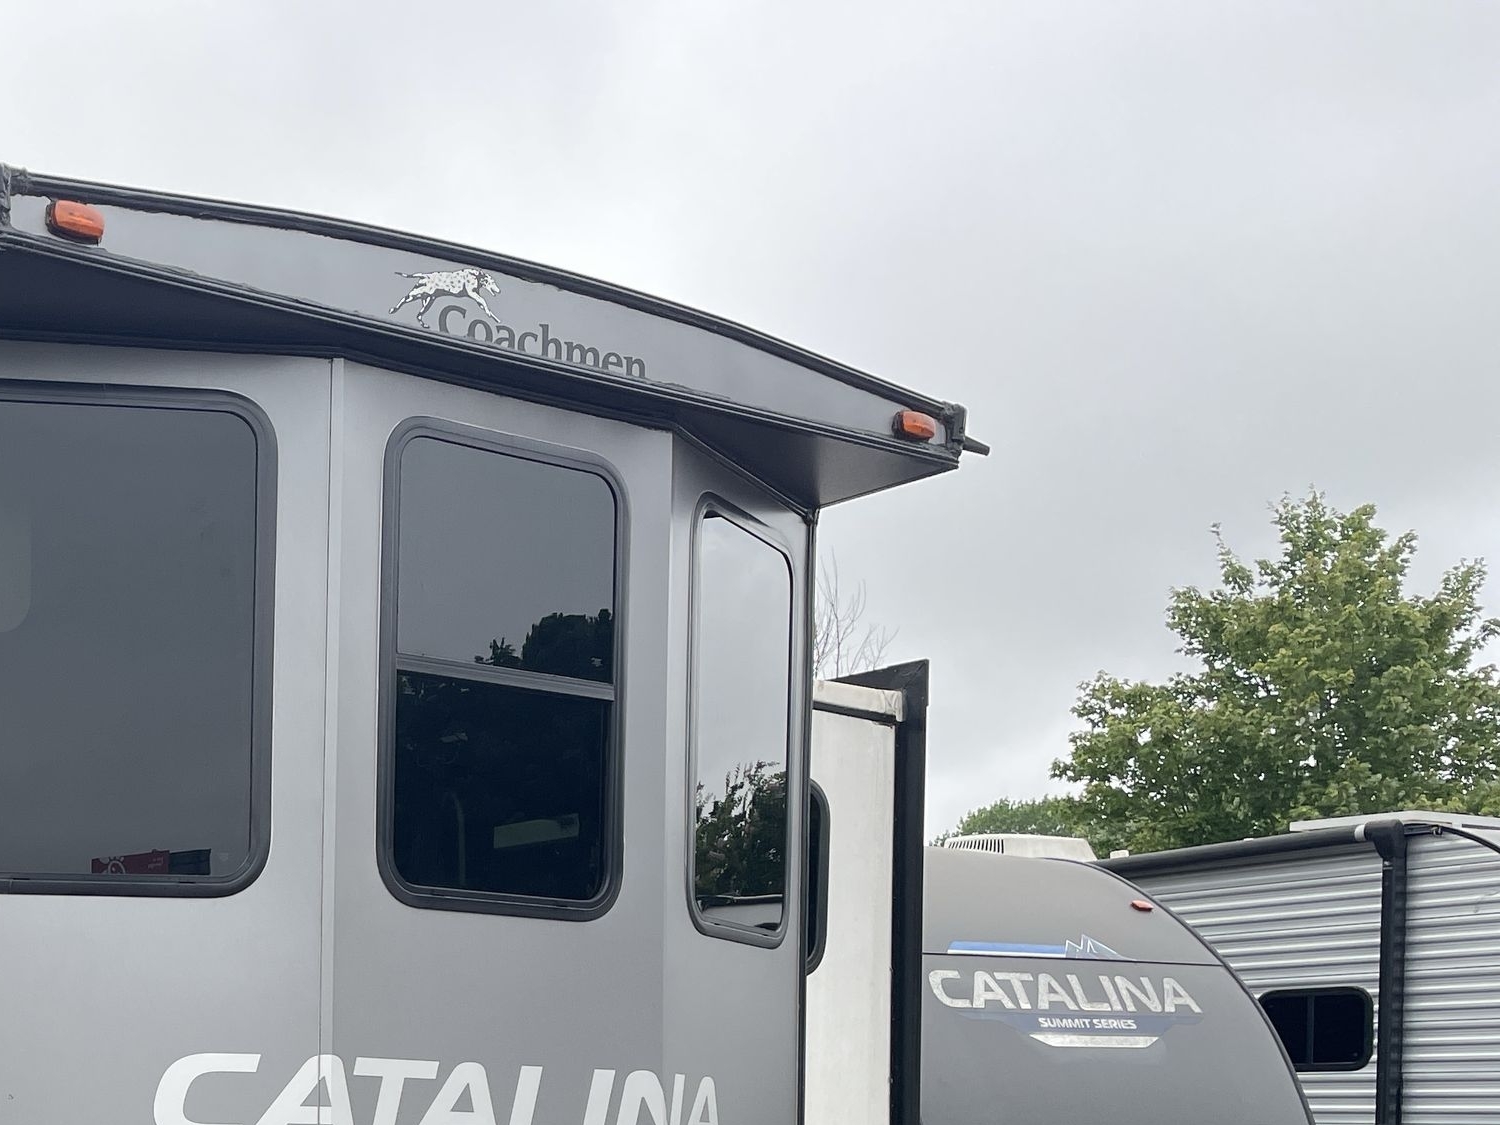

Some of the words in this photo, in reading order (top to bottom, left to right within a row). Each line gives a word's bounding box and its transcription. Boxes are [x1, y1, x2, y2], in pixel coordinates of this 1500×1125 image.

[437, 304, 647, 379] Coachmen
[928, 969, 1202, 1014] CATALINA
[1038, 1017, 1090, 1029] SUMMIT
[1092, 1019, 1137, 1030] SERIES
